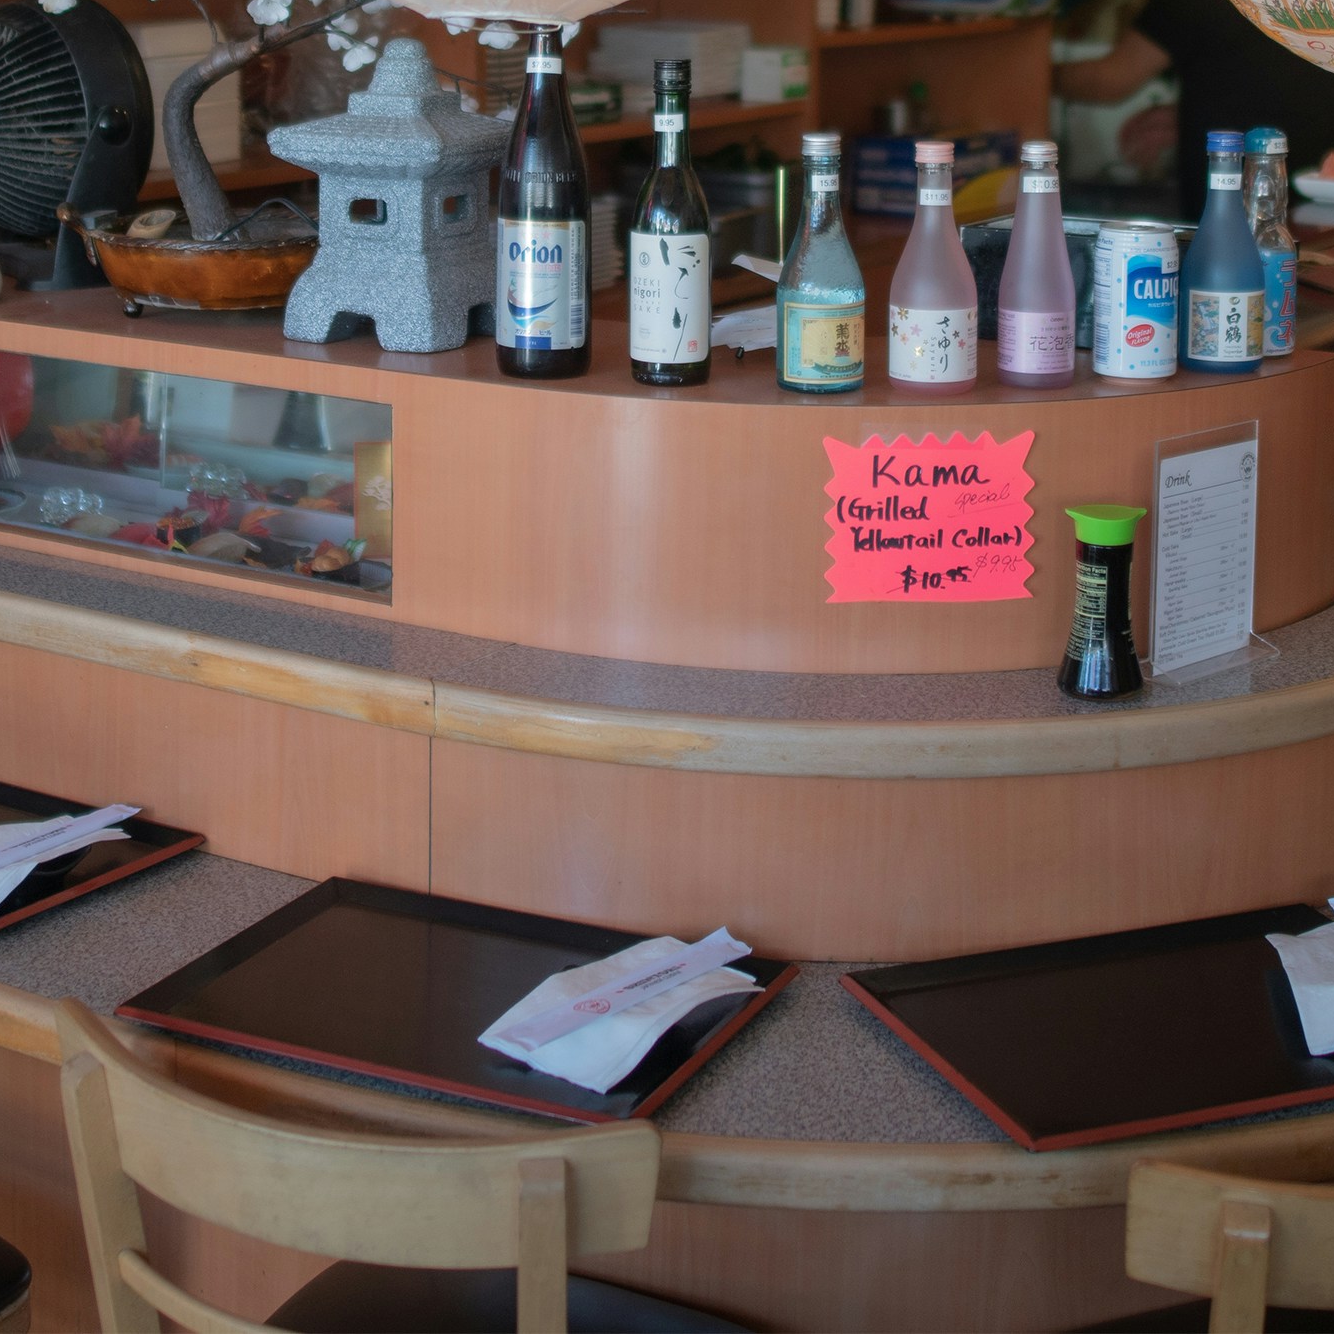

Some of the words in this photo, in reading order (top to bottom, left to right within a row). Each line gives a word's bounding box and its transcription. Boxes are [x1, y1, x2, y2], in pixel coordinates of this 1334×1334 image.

[659, 118, 674, 127] 9.95
[925, 193, 949, 201] $11.95
[509, 239, 562, 263] Orion
[633, 277, 660, 287] OZEKI
[1134, 279, 1179, 300] CALPIC
[634, 288, 661, 299] nigori
[1278, 260, 1296, 343] ラムネ
[634, 305, 660, 314] SAKE
[1128, 327, 1152, 339] Original
[1225, 308, 1242, 343] 白鶴
[835, 323, 850, 352] 菊水
[936, 316, 951, 373] さゆり
[1030, 334, 1075, 352] 花泡香
[1131, 336, 1151, 345] FLAVOR
[872, 454, 991, 488] Kama
[1165, 470, 1192, 488] Drink
[954, 483, 1011, 514] special
[837, 496, 930, 523] (Grilled
[951, 526, 1022, 548] Collar)
[973, 553, 1022, 578] $9.95
